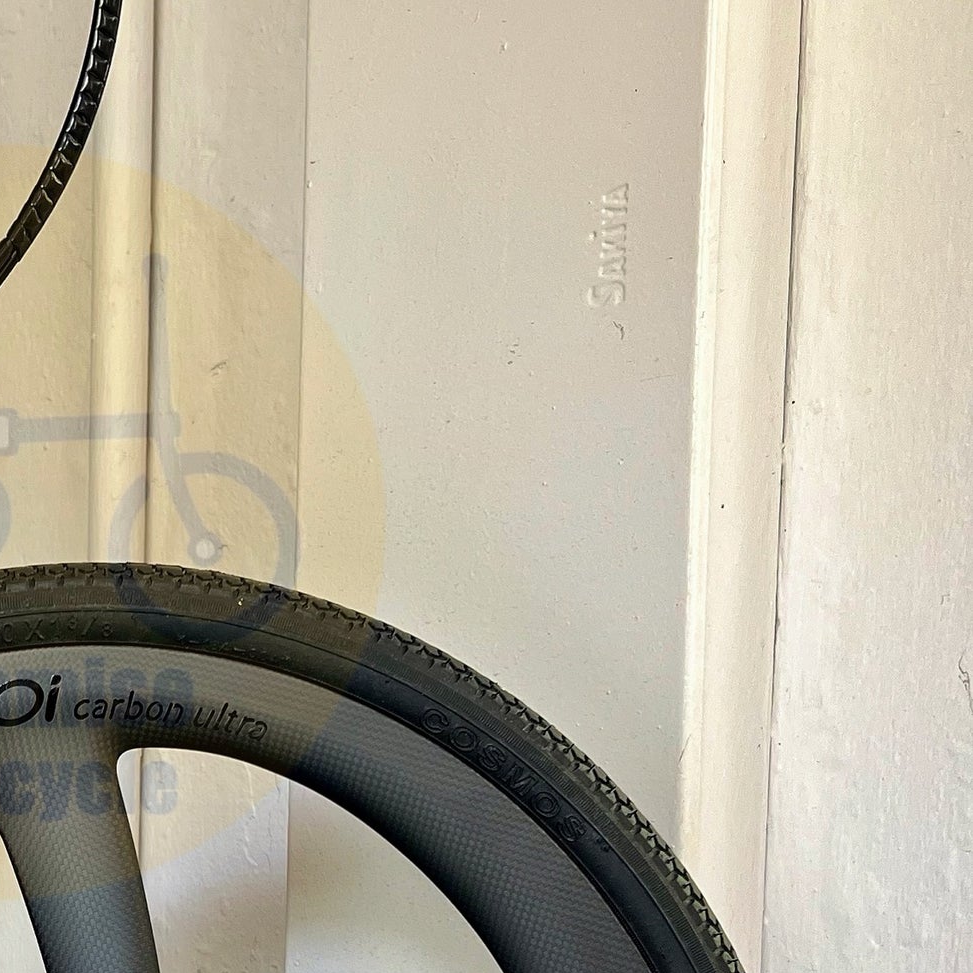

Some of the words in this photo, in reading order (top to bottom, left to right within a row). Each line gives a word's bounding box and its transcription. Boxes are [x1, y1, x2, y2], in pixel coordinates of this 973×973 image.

[73, 690, 183, 723] carbon
[193, 702, 268, 742] ultra
[421, 707, 588, 843] COSMOS
